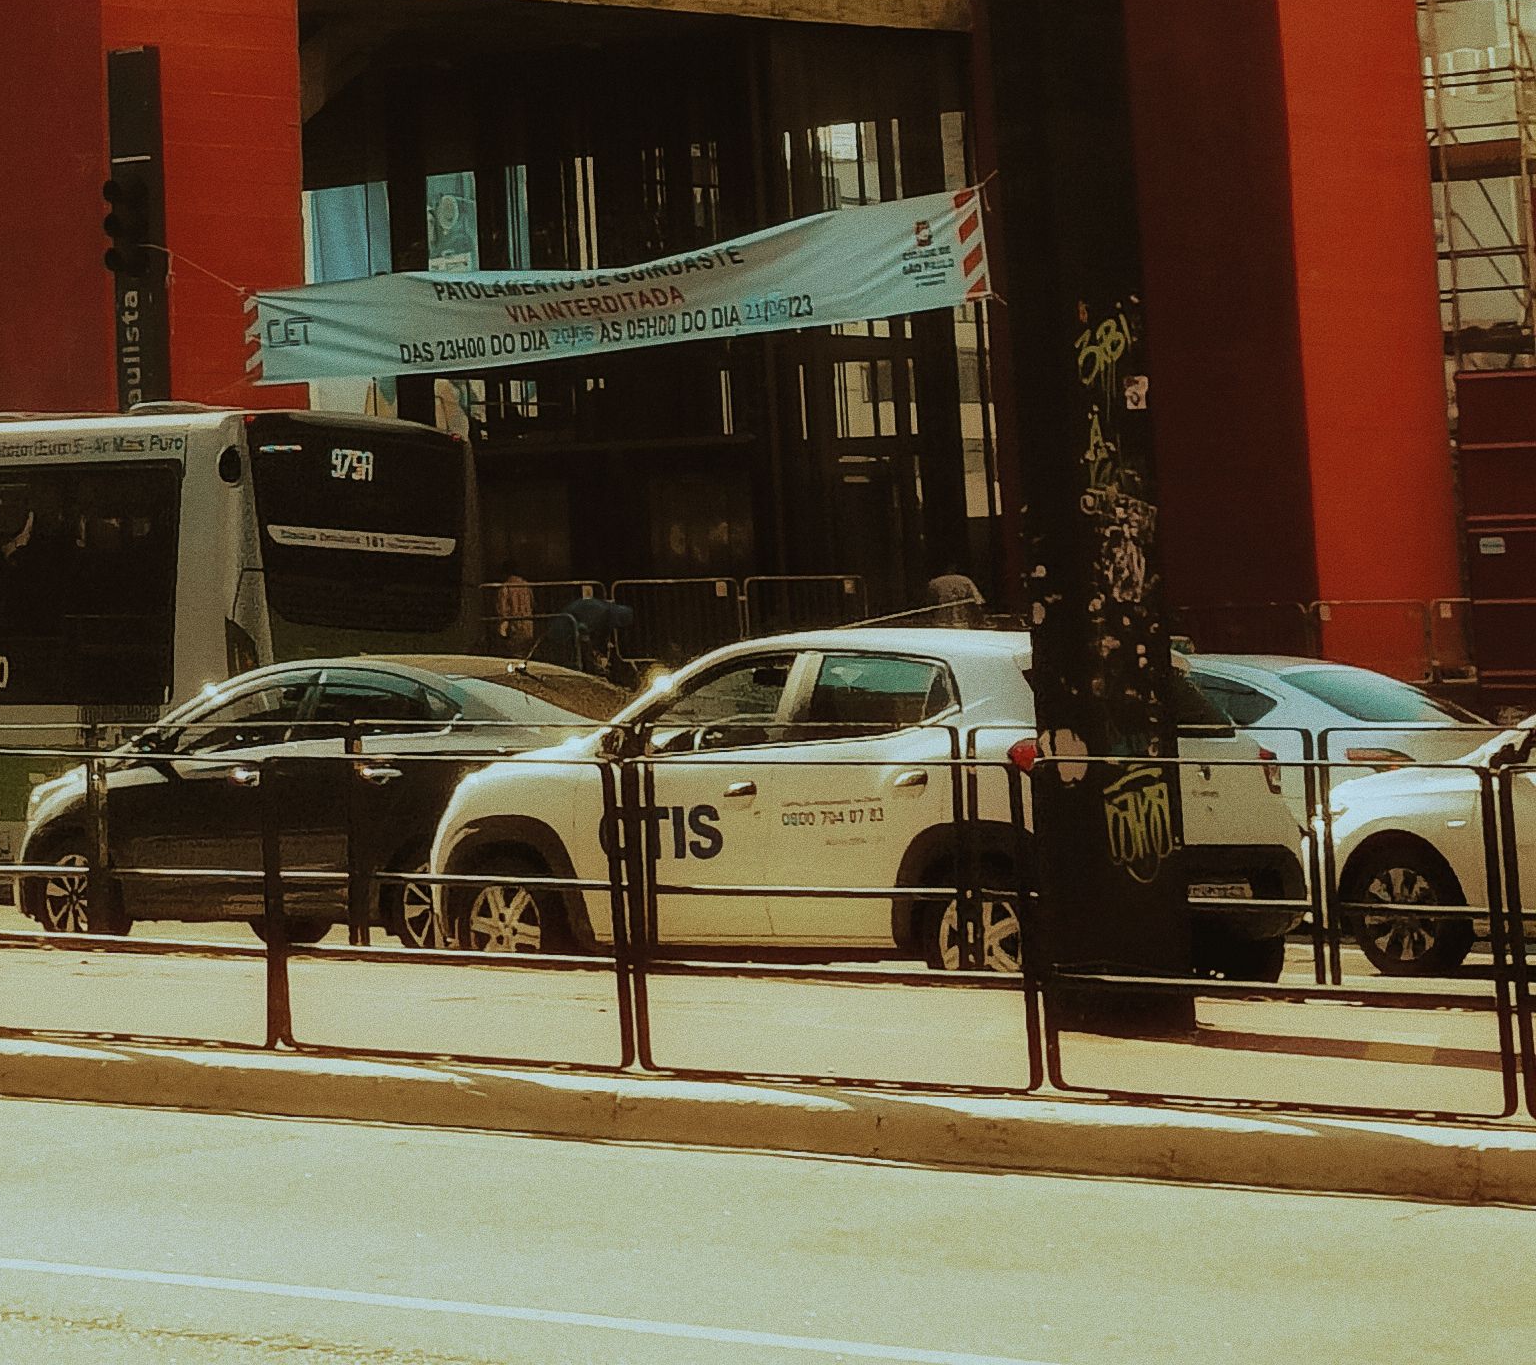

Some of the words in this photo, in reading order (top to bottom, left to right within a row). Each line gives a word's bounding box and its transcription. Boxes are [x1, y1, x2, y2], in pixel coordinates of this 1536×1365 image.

[505, 303, 541, 325] VIA
[542, 285, 686, 322] INTERDITADA
[121, 290, 142, 405] aulista
[266, 316, 313, 348] CET
[399, 339, 434, 365] DAS
[435, 335, 486, 361] 23H00
[489, 332, 515, 355] DO
[520, 329, 549, 353] DIA
[626, 313, 676, 341] 05H00
[681, 309, 707, 334] DO
[713, 305, 742, 329] DIA
[149, 434, 184, 451] Puro
